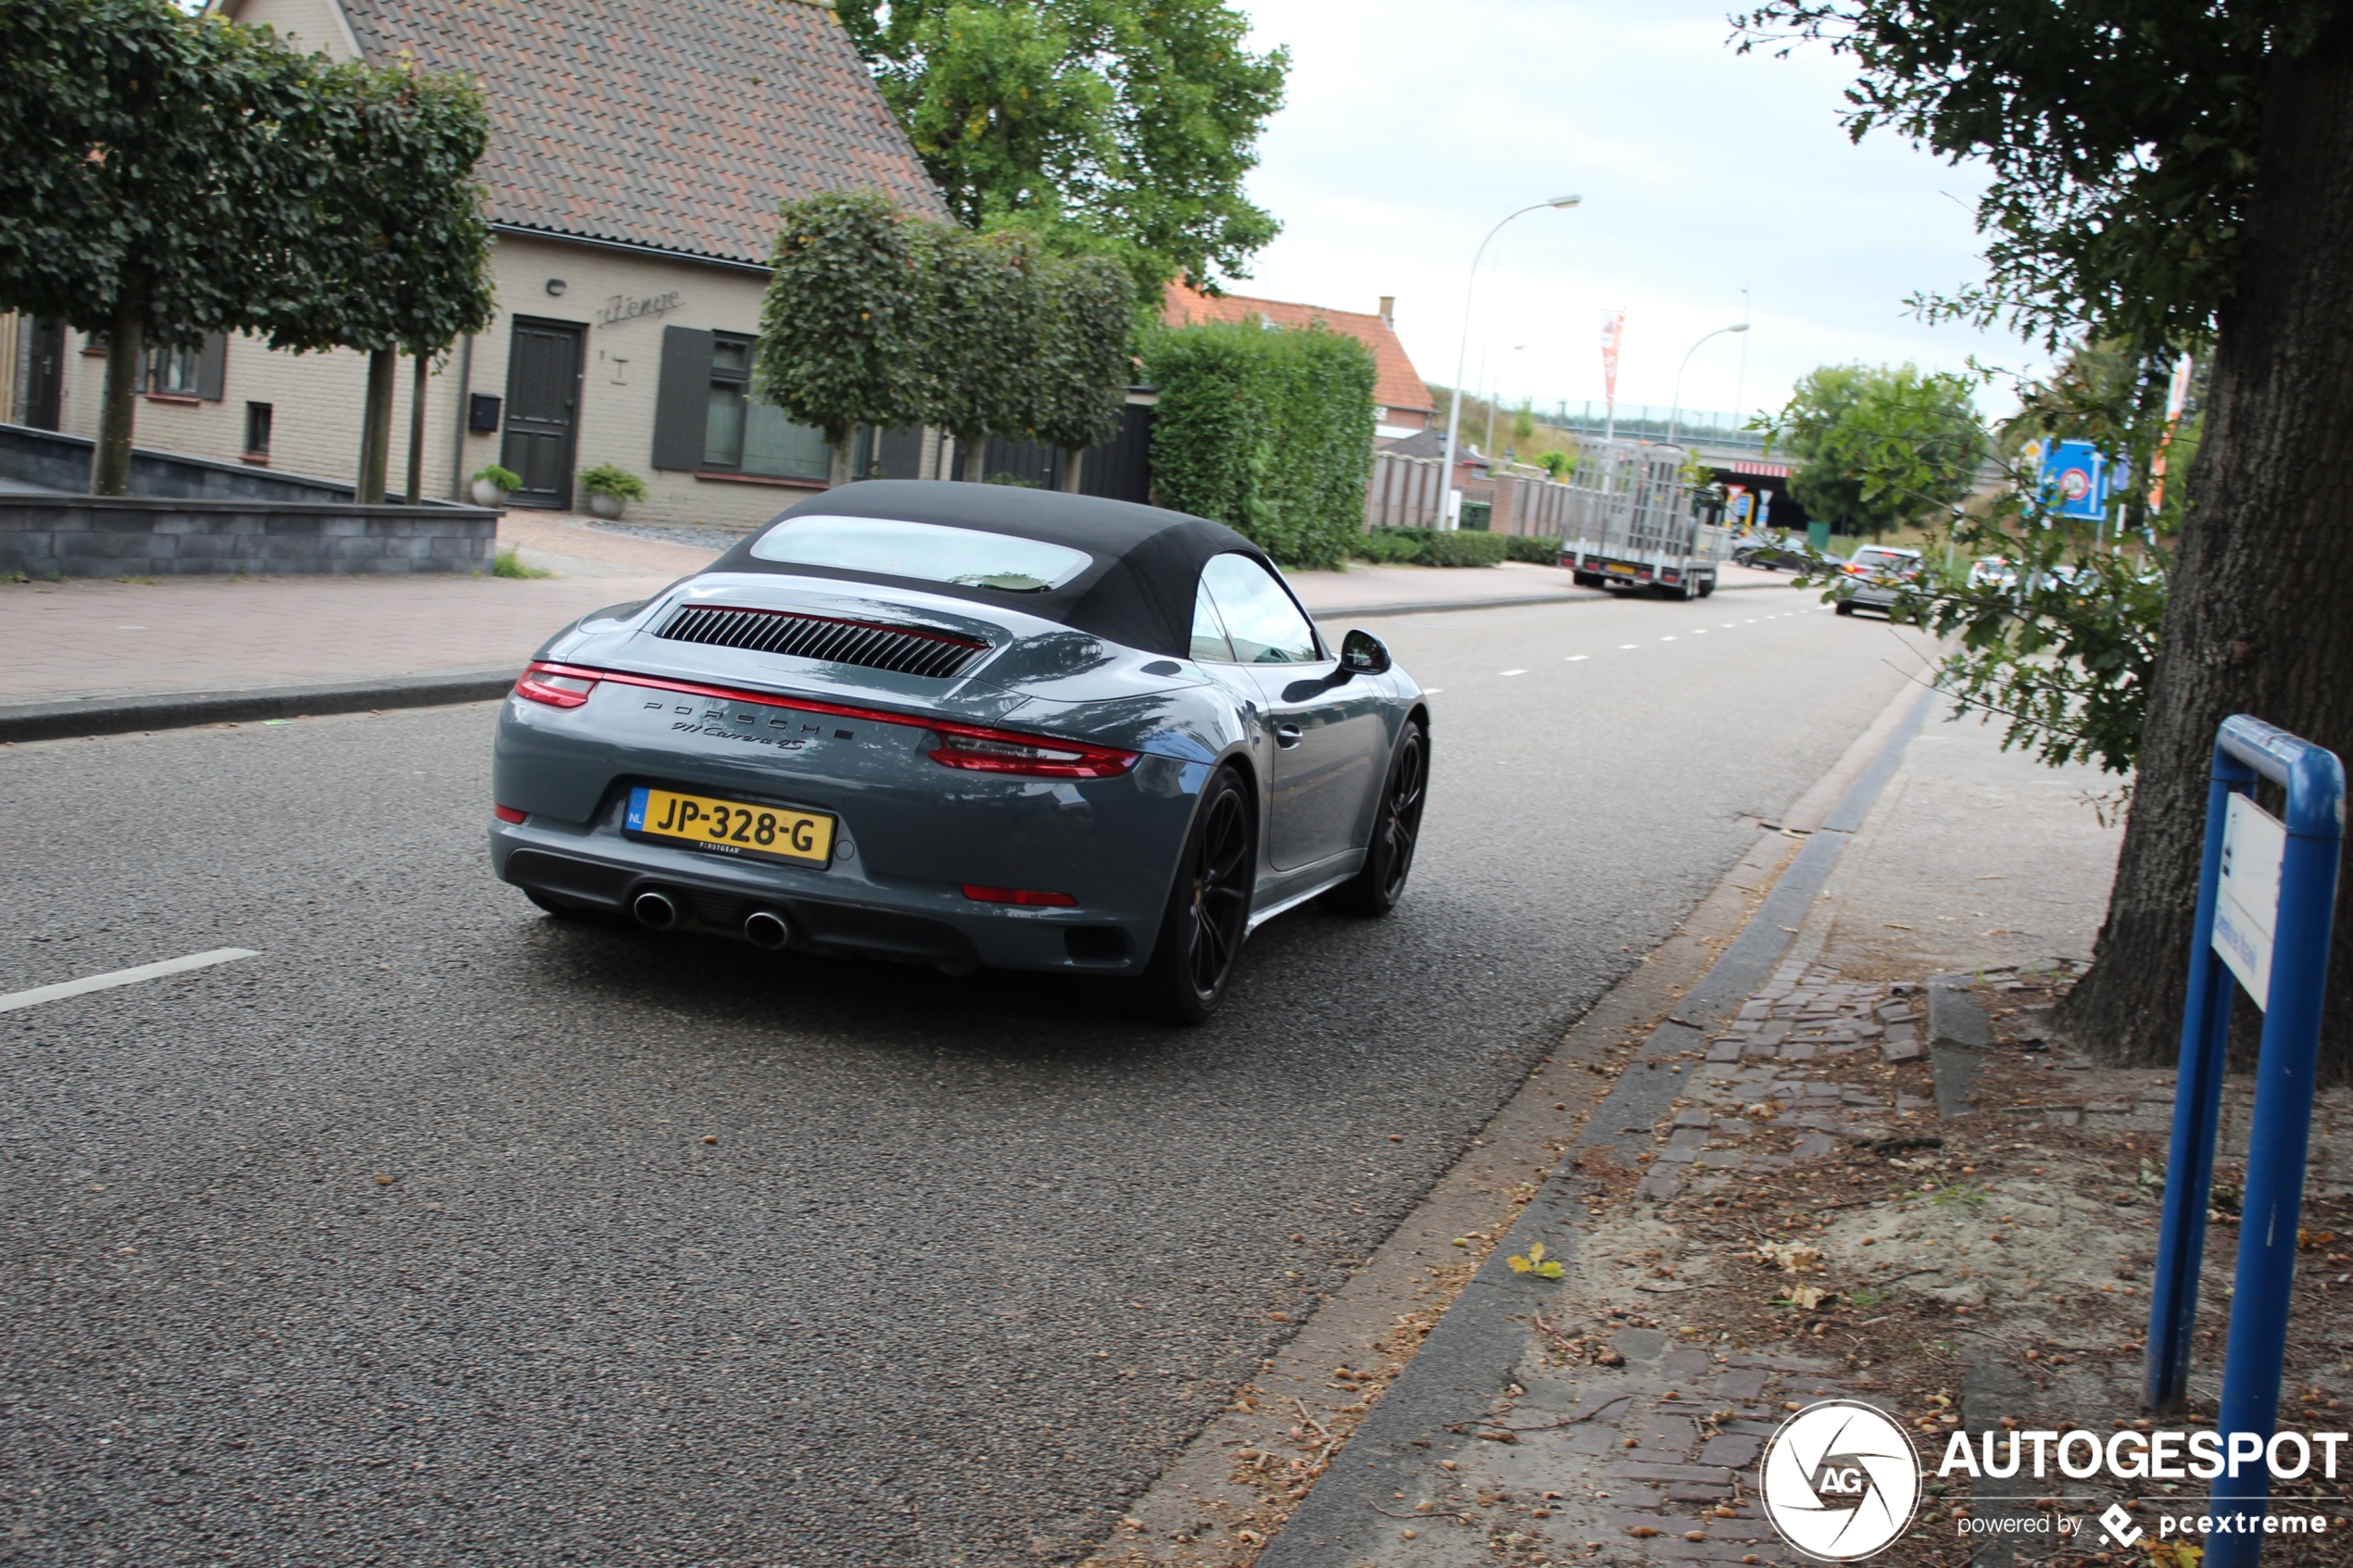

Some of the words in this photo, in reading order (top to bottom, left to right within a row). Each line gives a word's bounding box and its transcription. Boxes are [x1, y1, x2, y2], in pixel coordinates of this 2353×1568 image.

[644, 701, 854, 741] PORSCHE
[671, 721, 702, 733] 911
[702, 726, 773, 746] Carrera
[777, 739, 807, 751] 4S
[628, 812, 643, 825] NL
[657, 797, 815, 853] JP-328-G
